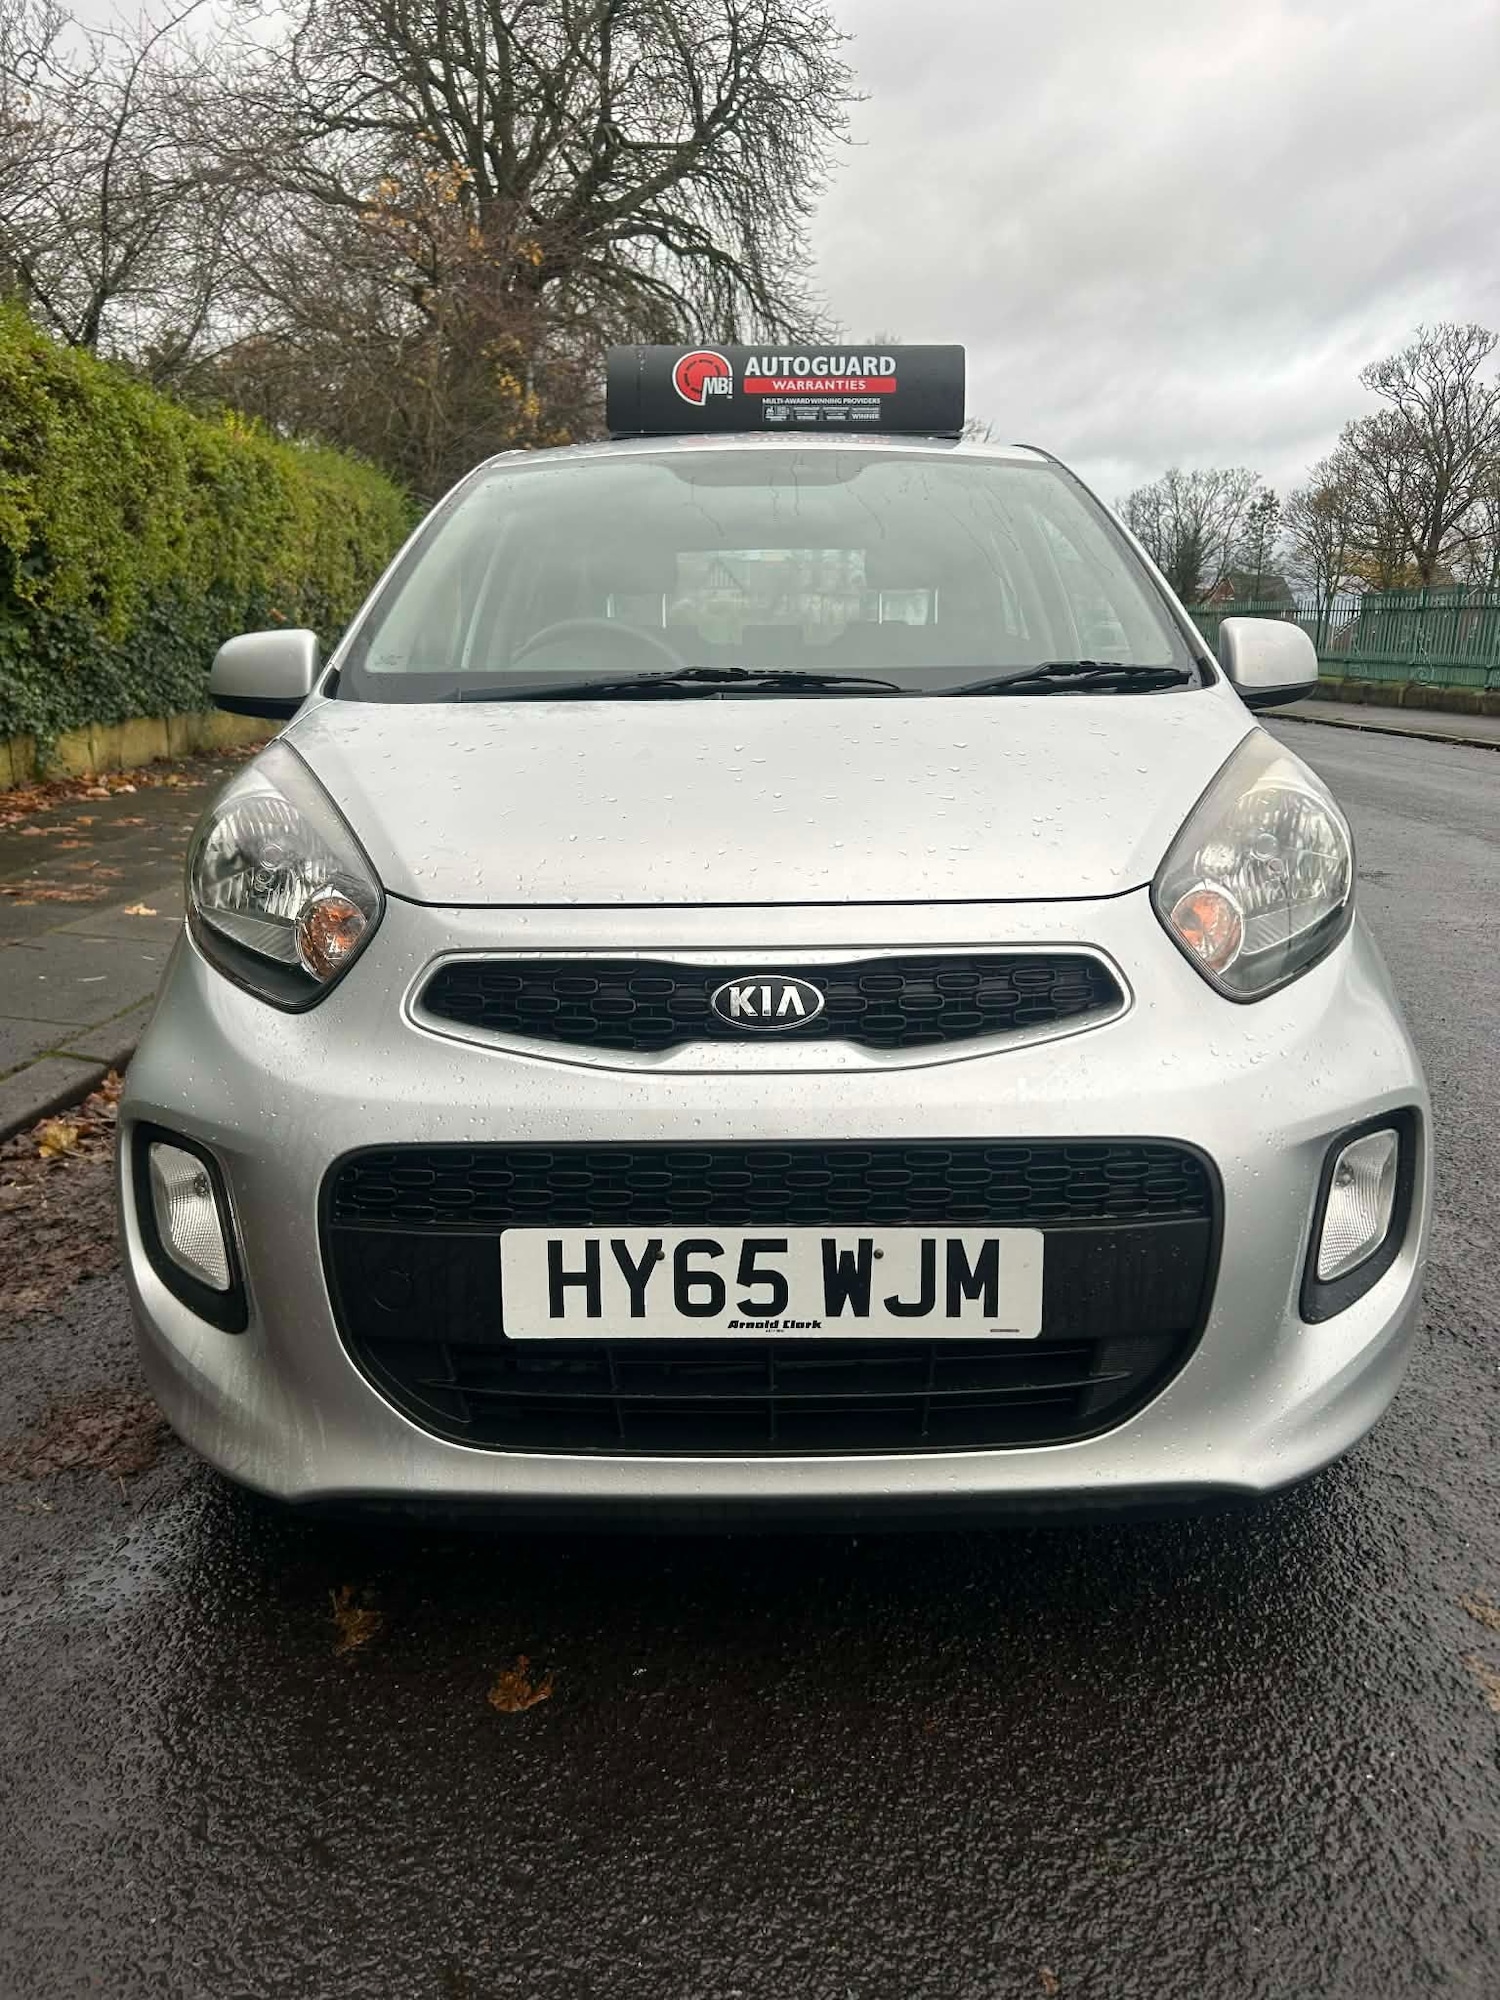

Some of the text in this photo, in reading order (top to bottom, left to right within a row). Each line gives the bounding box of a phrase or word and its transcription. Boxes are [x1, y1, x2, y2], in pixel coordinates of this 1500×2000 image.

[744, 356, 896, 376] AUTOGUARD
[772, 380, 866, 391] WARRANTIES
[728, 985, 806, 1017] KIA
[547, 1238, 1000, 1319] HY65 WJM
[727, 1320, 822, 1329] Arnold Clark
